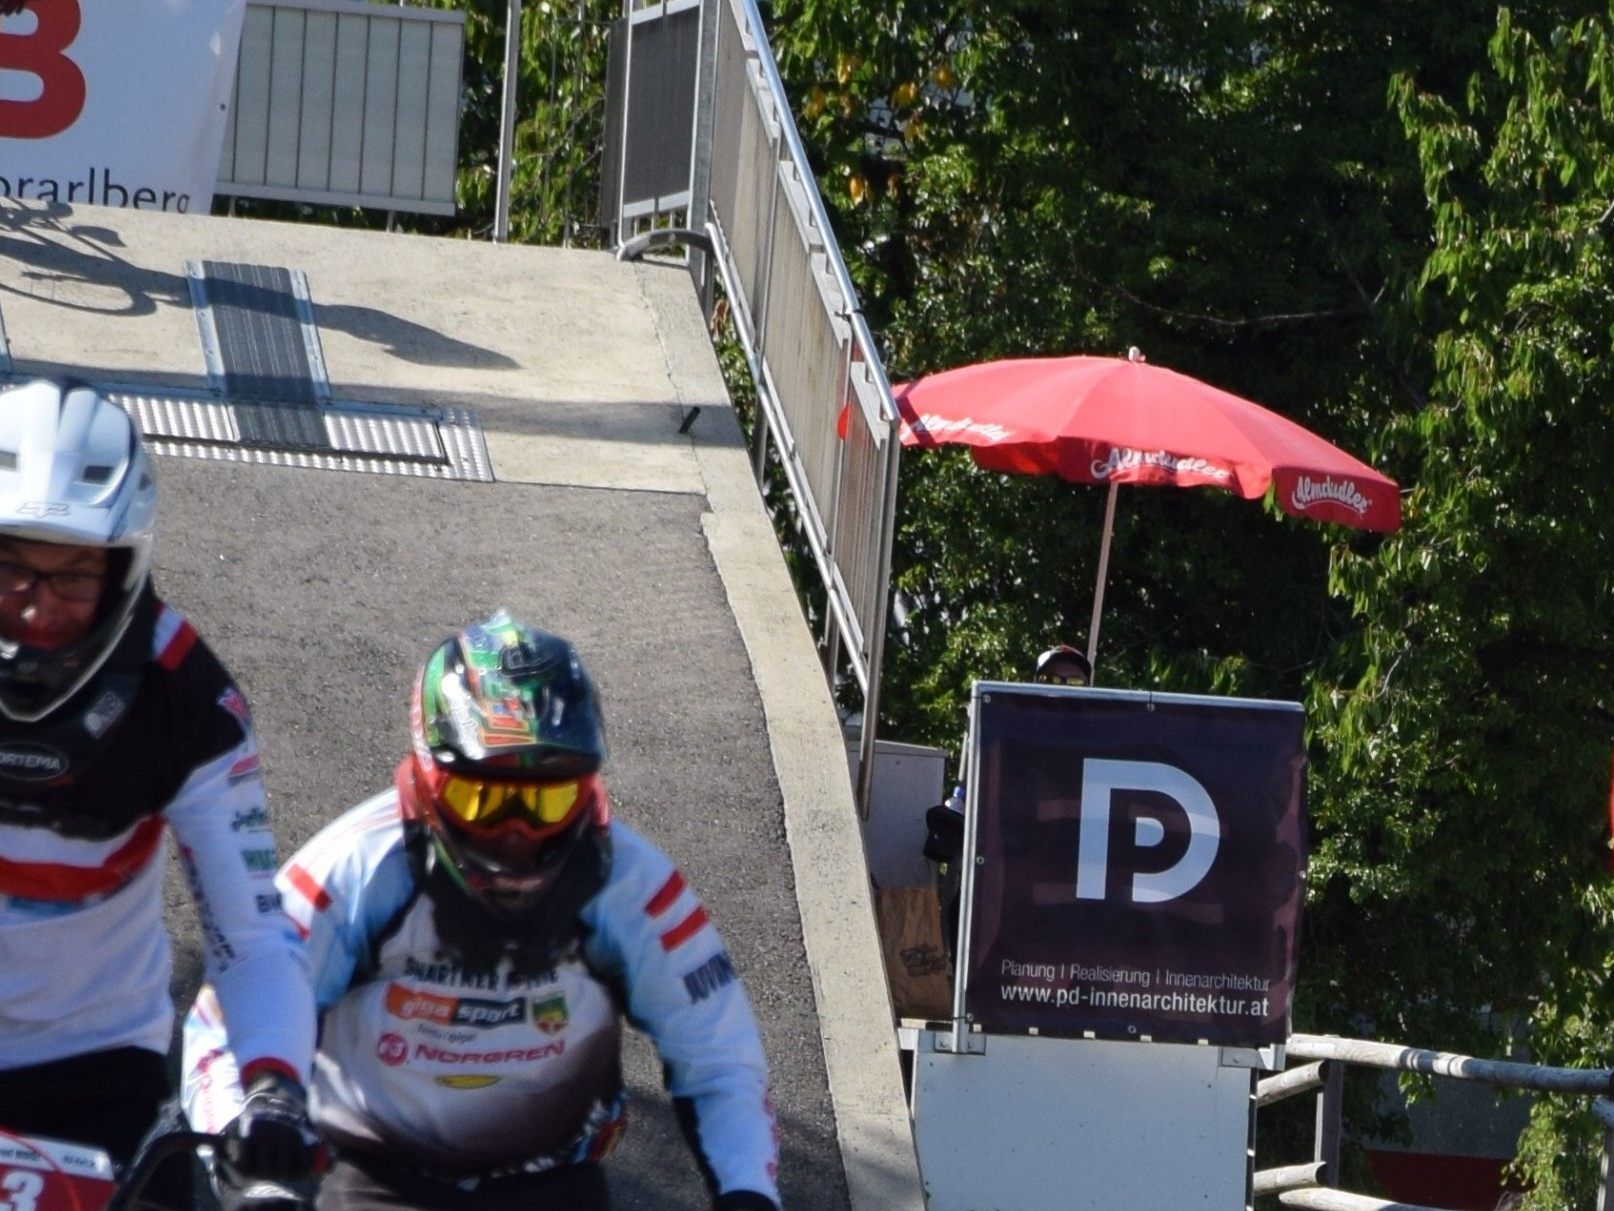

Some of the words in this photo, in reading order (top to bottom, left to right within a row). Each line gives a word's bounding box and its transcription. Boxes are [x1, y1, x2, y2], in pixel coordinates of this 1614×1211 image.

[1292, 475, 1368, 514] Almdudler
[1001, 959, 1055, 982] Planung
[1070, 963, 1150, 987] Realisierung
[1165, 969, 1270, 992] Innenarchitektur
[1001, 985, 1270, 1017] www.pd-innenarchitektur.at
[413, 1040, 566, 1064] NORGREN
